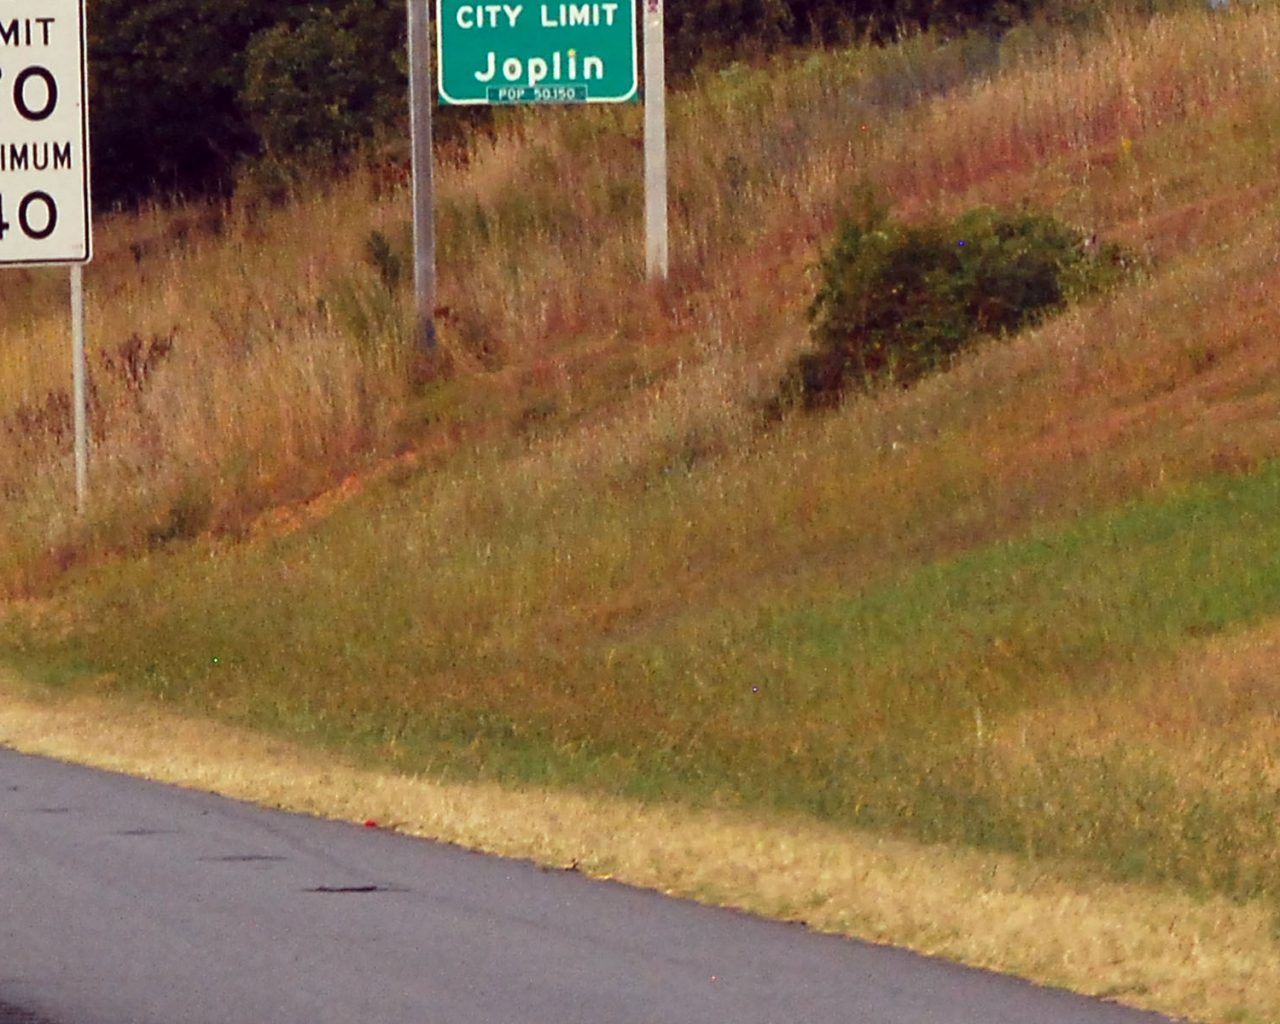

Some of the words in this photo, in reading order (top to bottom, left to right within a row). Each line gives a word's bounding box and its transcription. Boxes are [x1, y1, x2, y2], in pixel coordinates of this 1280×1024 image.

[456, 4, 524, 29] CITY
[540, 3, 619, 27] LIMIT
[474, 48, 605, 87] Joplin
[498, 88, 525, 100] POP
